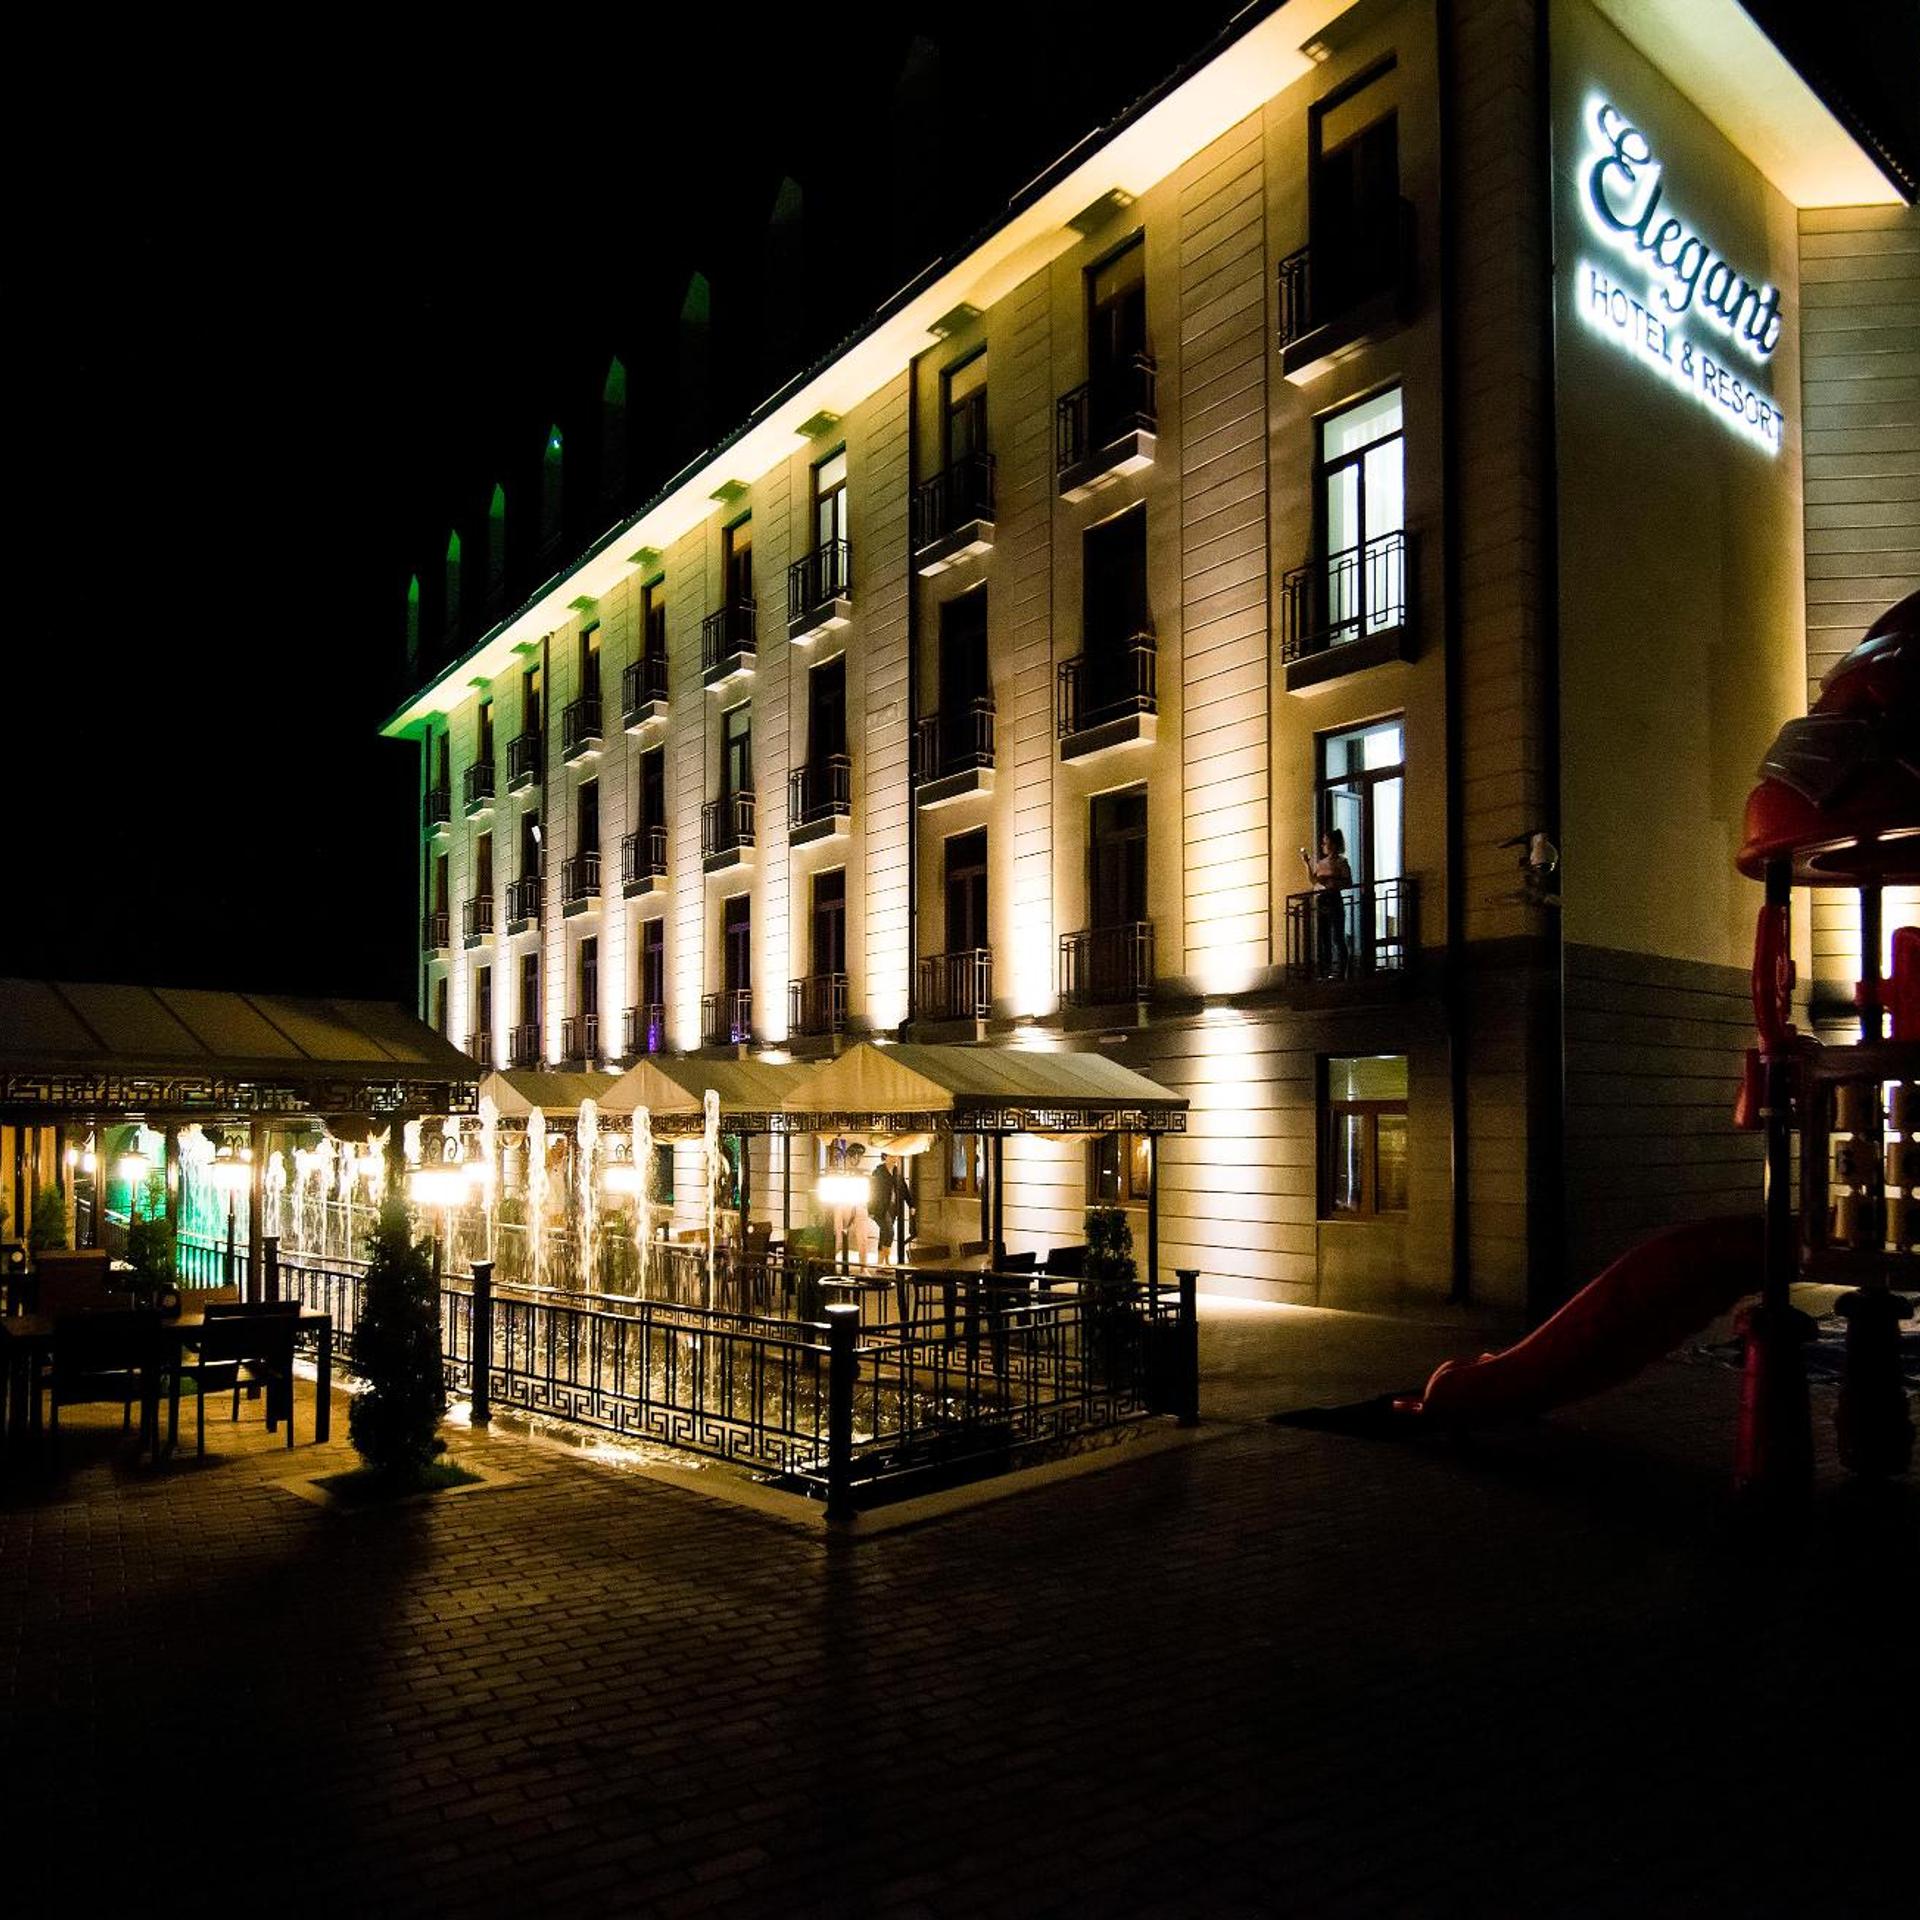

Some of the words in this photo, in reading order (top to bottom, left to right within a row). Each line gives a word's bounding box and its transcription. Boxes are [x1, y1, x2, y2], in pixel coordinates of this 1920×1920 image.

[1589, 103, 1783, 355] Elegant
[1590, 271, 1673, 364] HOTEL
[1681, 341, 1695, 380] &
[1702, 356, 1784, 448] RESORT
